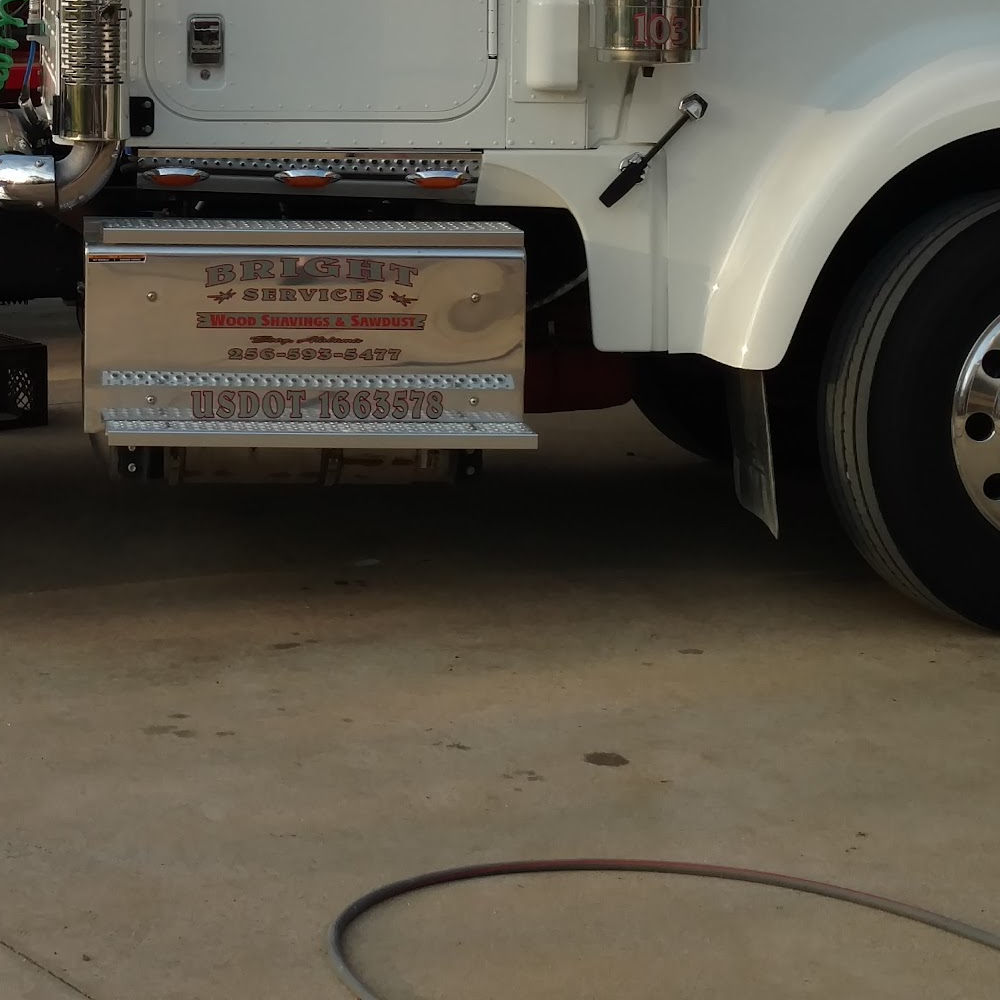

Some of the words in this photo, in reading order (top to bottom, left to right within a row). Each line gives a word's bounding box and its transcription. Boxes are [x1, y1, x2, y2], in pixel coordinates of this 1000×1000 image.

[633, 12, 689, 46] 103
[205, 257, 418, 287] BRIGHT
[242, 288, 384, 302] SERVICES
[335, 316, 346, 327] &
[228, 348, 402, 361] 256-593-5477
[191, 390, 307, 419] USDOT
[318, 390, 444, 419] 1663578
